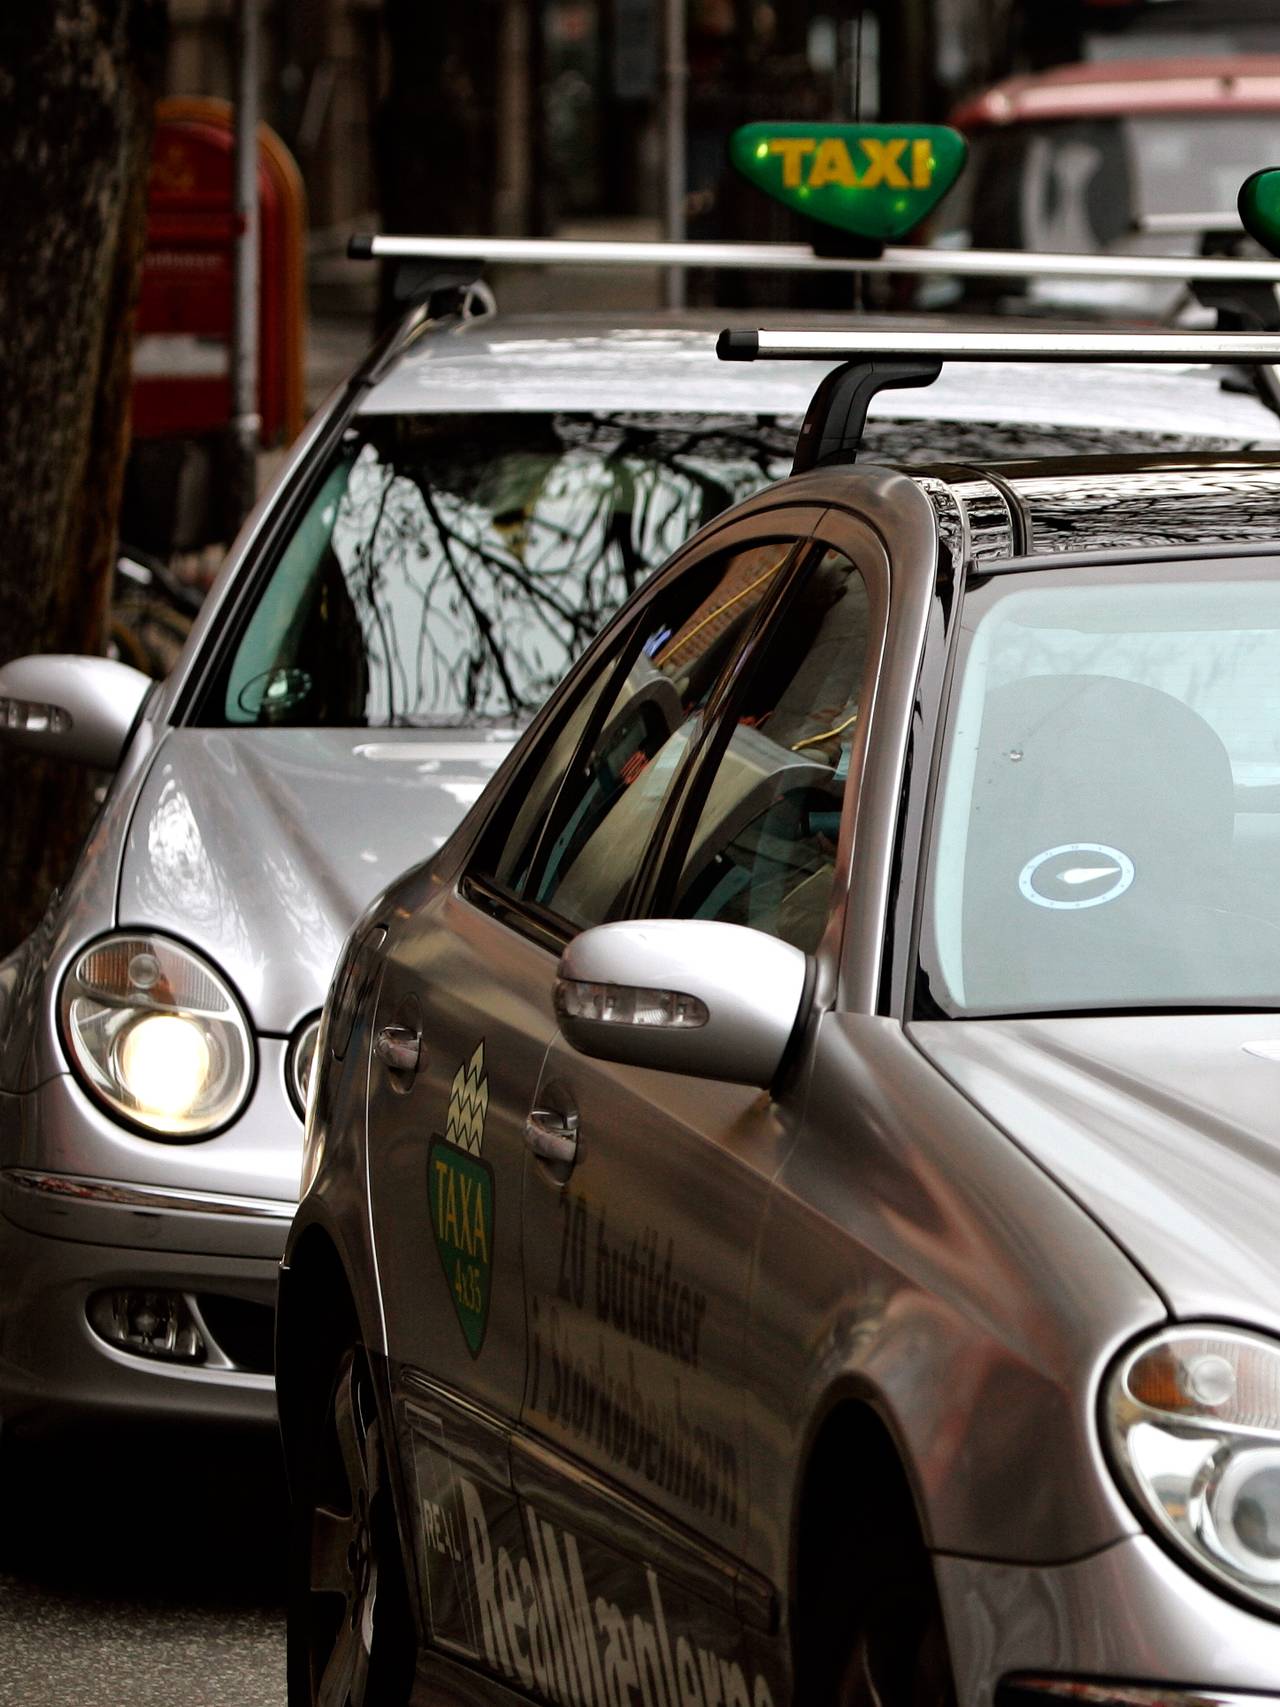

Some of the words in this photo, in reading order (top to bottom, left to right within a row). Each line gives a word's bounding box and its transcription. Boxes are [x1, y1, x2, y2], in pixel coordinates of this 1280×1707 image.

[770, 137, 933, 188] TAXI
[436, 1159, 488, 1264] TAXA
[596, 1206, 706, 1369] butikker
